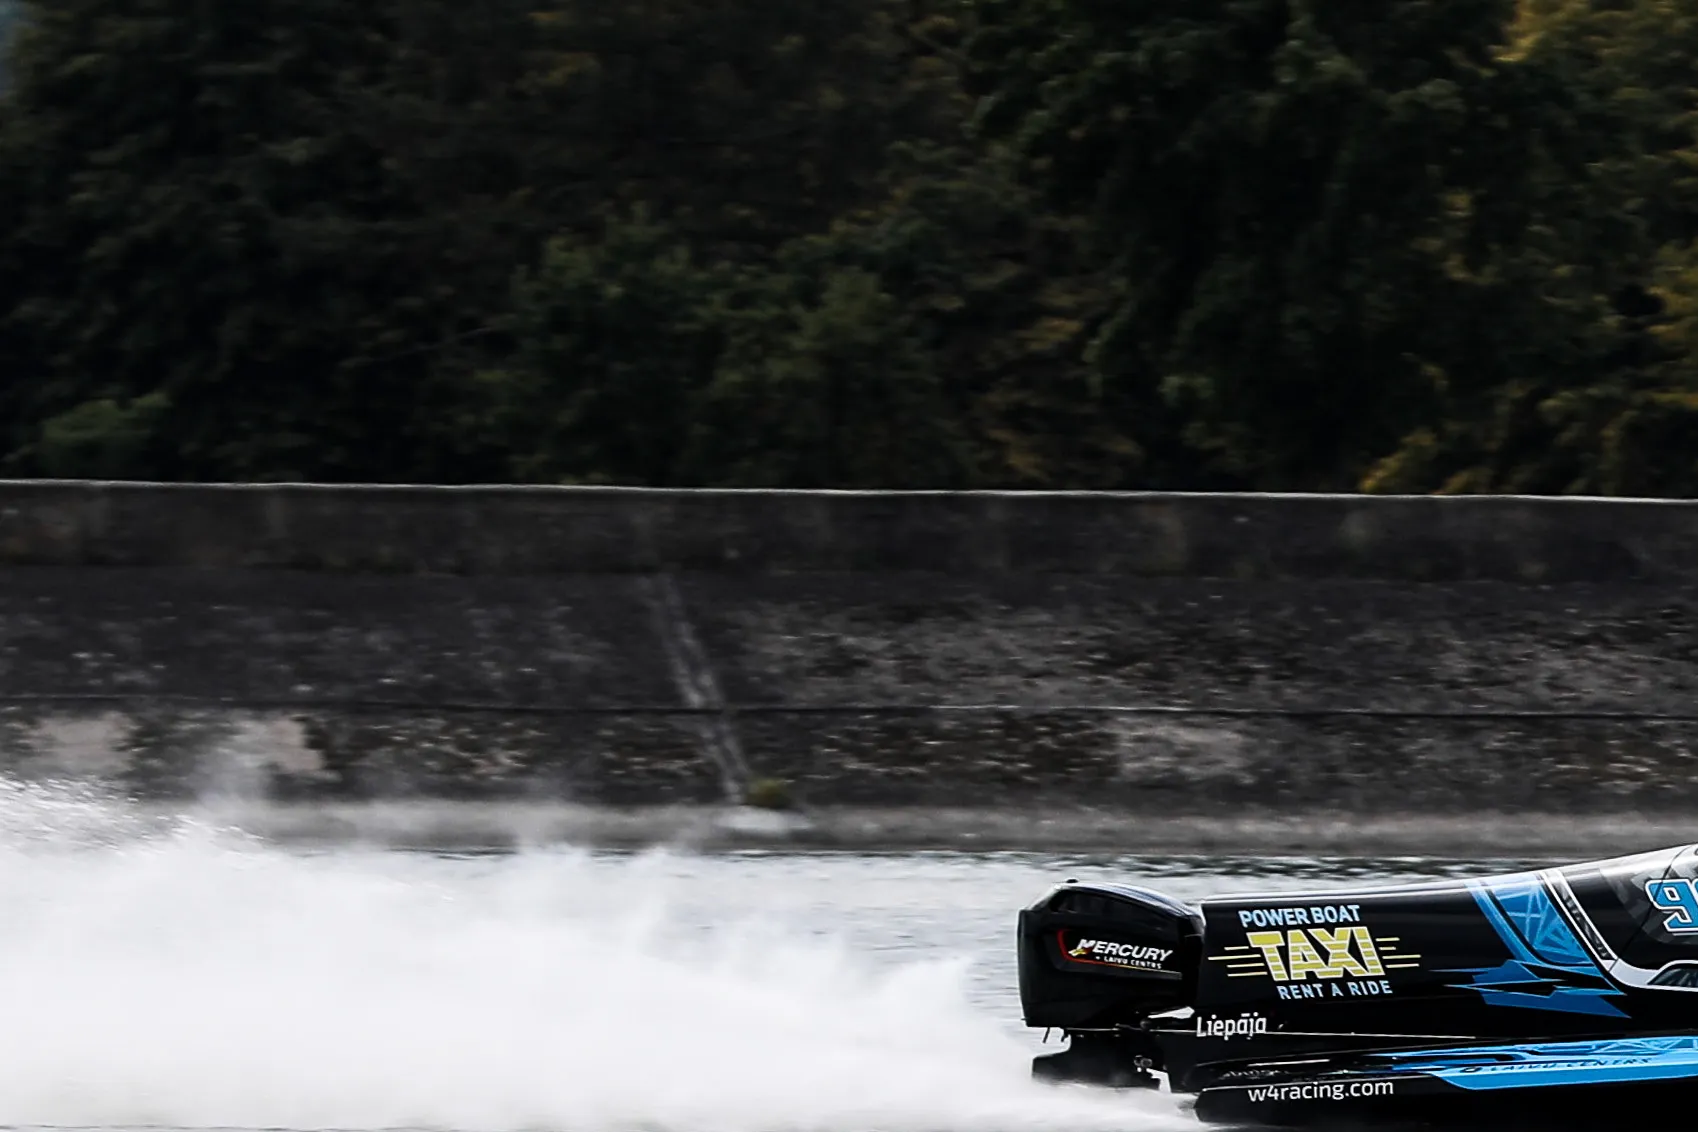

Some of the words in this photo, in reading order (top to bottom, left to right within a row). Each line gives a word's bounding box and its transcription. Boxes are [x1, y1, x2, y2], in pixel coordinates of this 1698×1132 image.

[1238, 908, 1311, 928] POWER
[1310, 904, 1360, 924] BOAT
[1069, 938, 1174, 962] MERCURY
[1246, 926, 1386, 982] TAXI
[1276, 983, 1324, 1001] RENT
[1331, 982, 1344, 997] A
[1347, 980, 1393, 996] RIDE
[1196, 1011, 1267, 1041] Liepāja
[1248, 1080, 1395, 1103] w4racing.com
